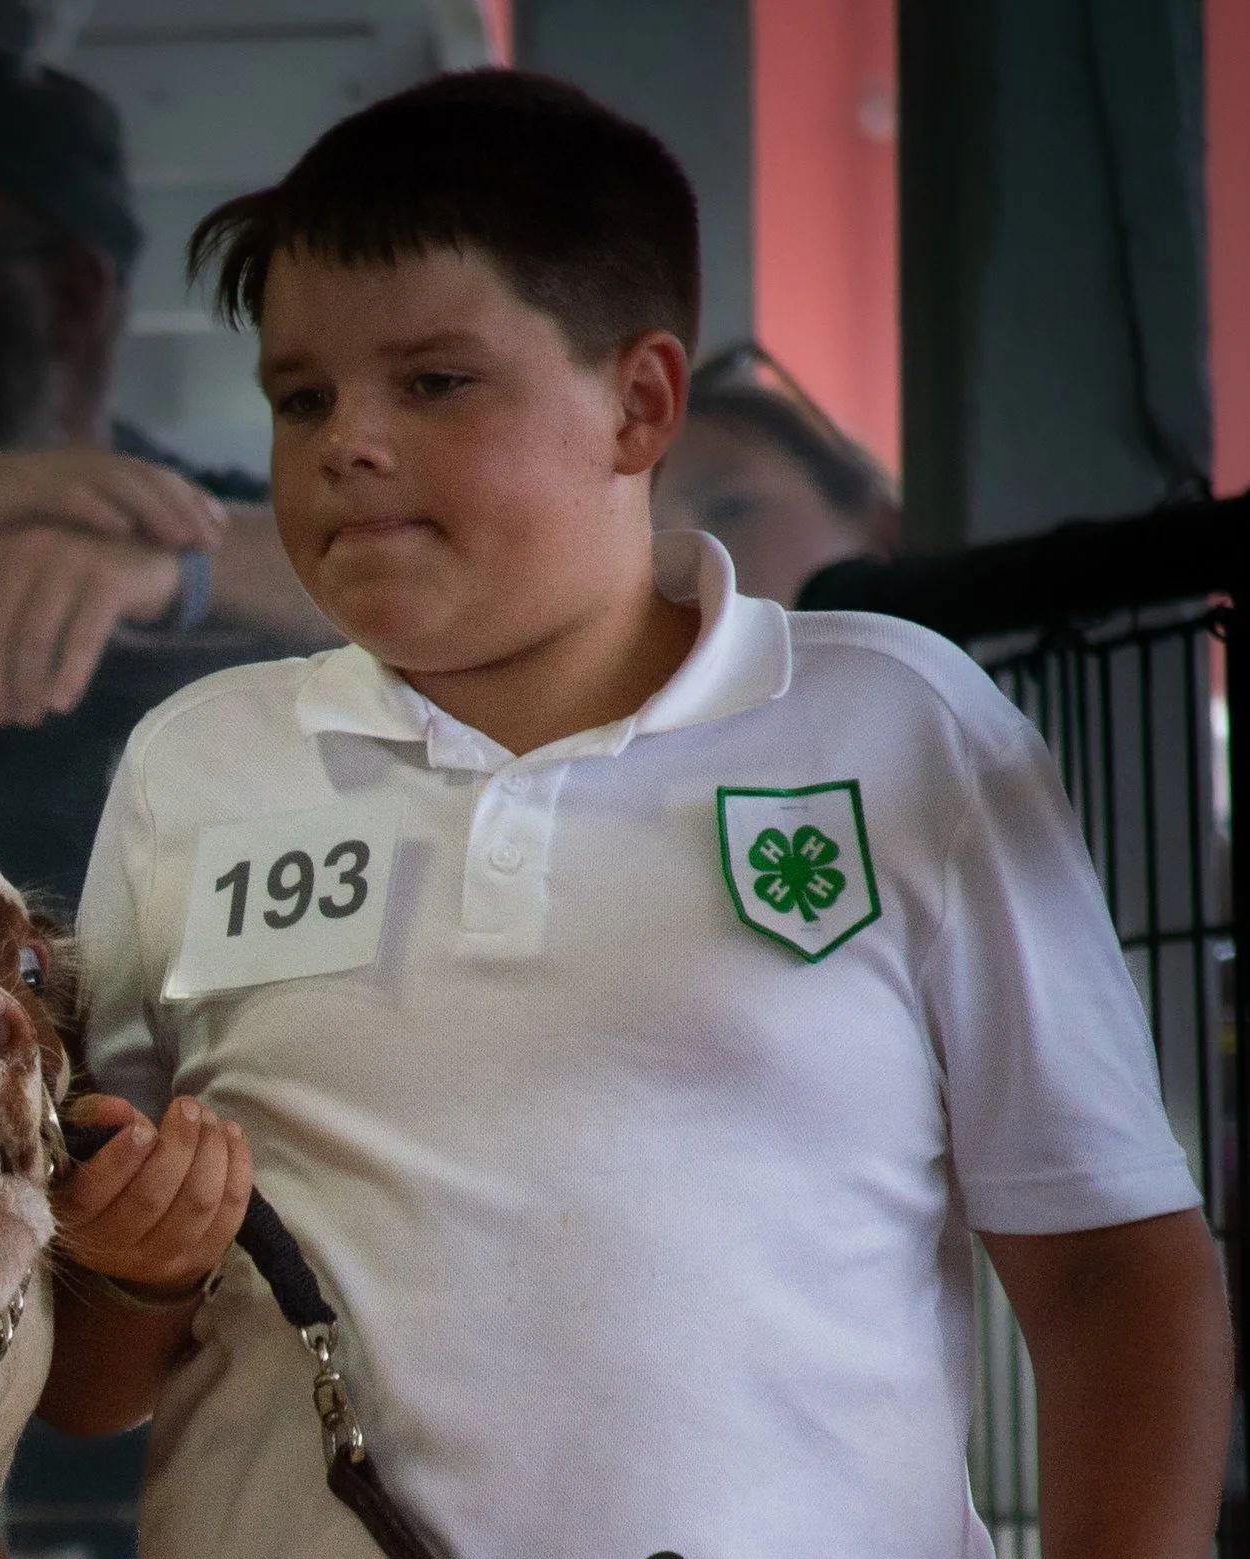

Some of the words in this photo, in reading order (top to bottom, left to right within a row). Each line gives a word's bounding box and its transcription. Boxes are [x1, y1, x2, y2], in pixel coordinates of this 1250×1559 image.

[759, 839, 785, 865] H
[799, 836, 826, 862] H
[215, 839, 370, 937] 193
[766, 877, 791, 903] H
[807, 874, 834, 900] H
